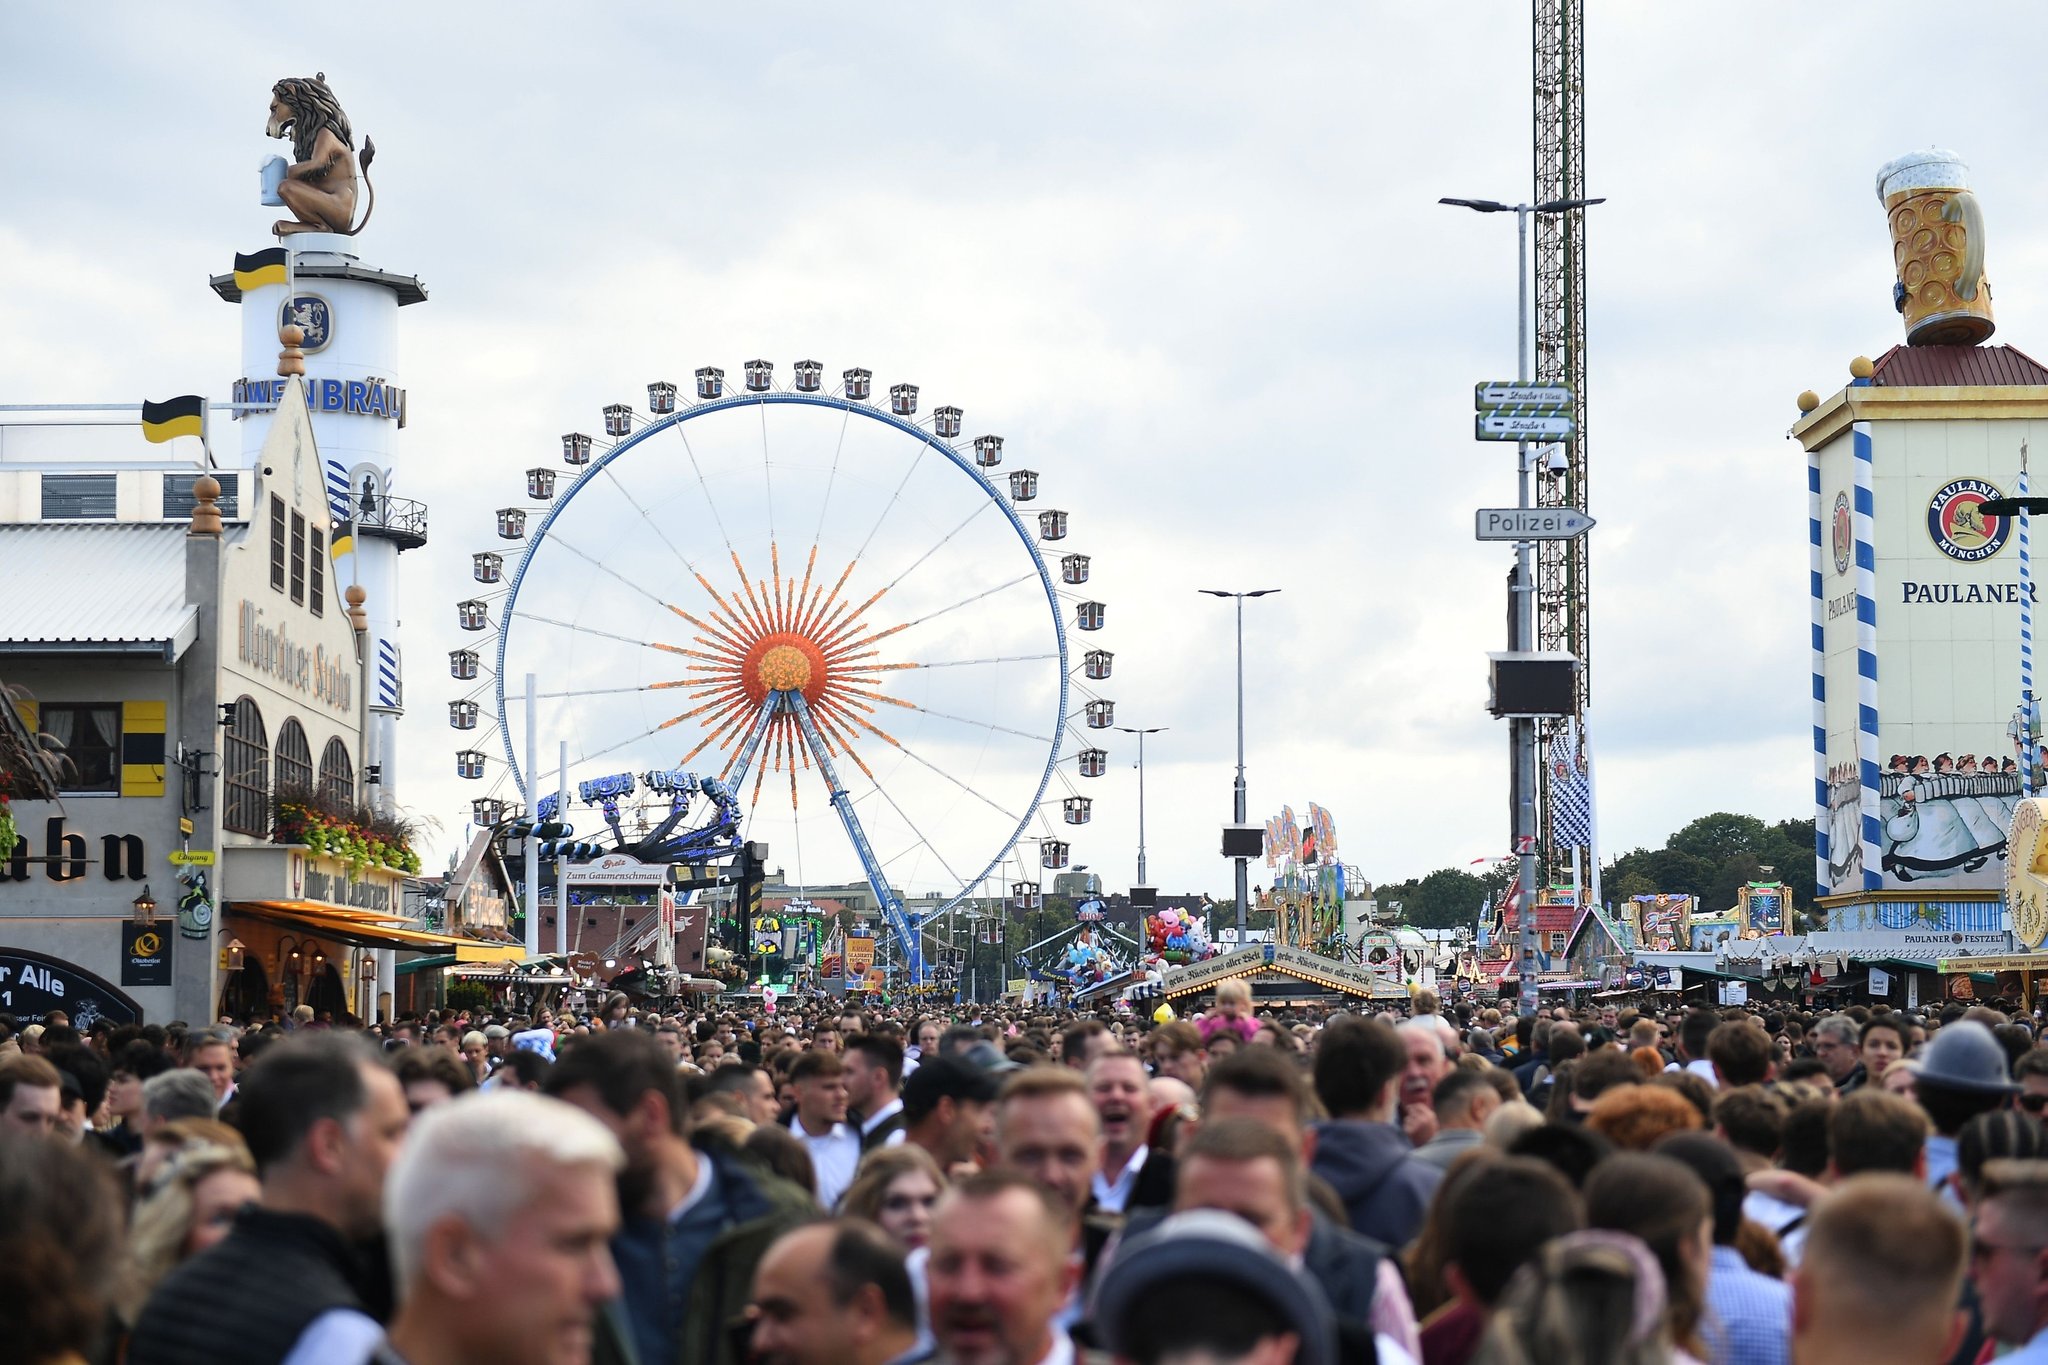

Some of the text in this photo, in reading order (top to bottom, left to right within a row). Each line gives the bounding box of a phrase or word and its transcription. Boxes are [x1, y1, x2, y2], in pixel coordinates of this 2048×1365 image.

[1508, 391, 1537, 400] Straße
[1510, 420, 1538, 430] Straße
[1931, 480, 2003, 511] PAULANE
[1489, 513, 1561, 531] Polizei
[1938, 538, 2002, 560] MÜNCHEN
[566, 871, 662, 880] Zum Gaumenschmaus
[1078, 912, 1104, 920] SHOP
[1905, 934, 2005, 943] PAULANER FESTZELT
[1212, 962, 1225, 973] aus
[1226, 955, 1241, 969] aller
[1320, 966, 1333, 974] aus
[1334, 967, 1351, 979] aller
[19, 965, 64, 997] Alle
